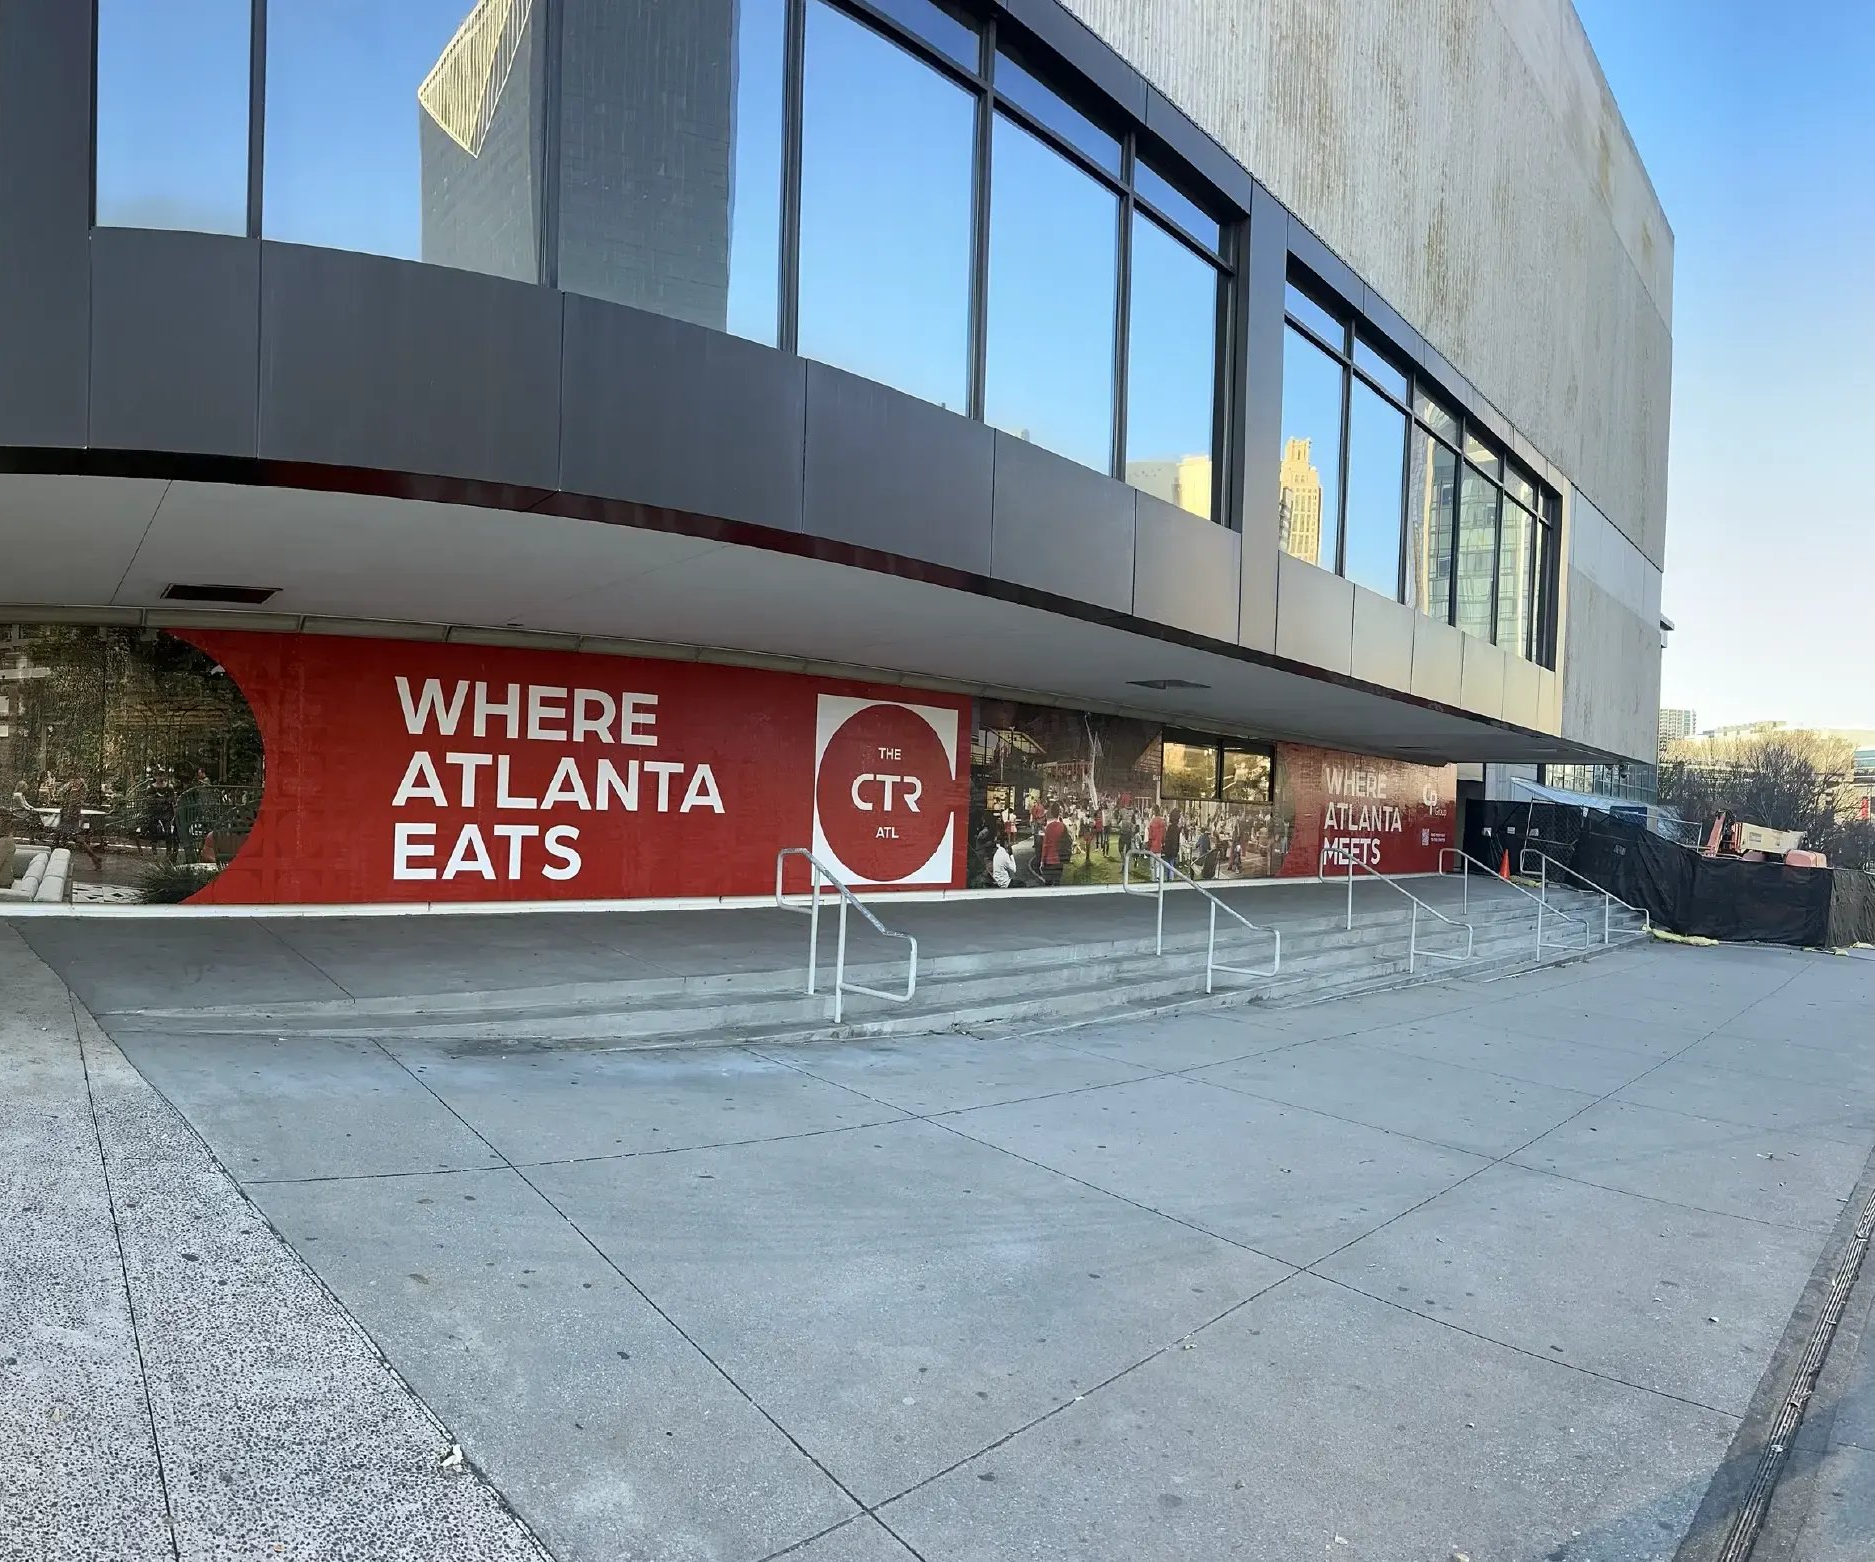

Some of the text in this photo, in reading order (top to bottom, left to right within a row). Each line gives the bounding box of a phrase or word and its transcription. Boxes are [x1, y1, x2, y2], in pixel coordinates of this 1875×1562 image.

[395, 675, 659, 746] WHERE
[878, 747, 902, 760] THE
[391, 751, 726, 814] ATLANTA
[851, 773, 922, 813] CTR
[1326, 767, 1387, 799] WHERE
[875, 826, 900, 839] ATL
[1324, 801, 1402, 833] ATLANTA
[392, 822, 582, 881] EATS
[1323, 836, 1381, 866] MEETS
